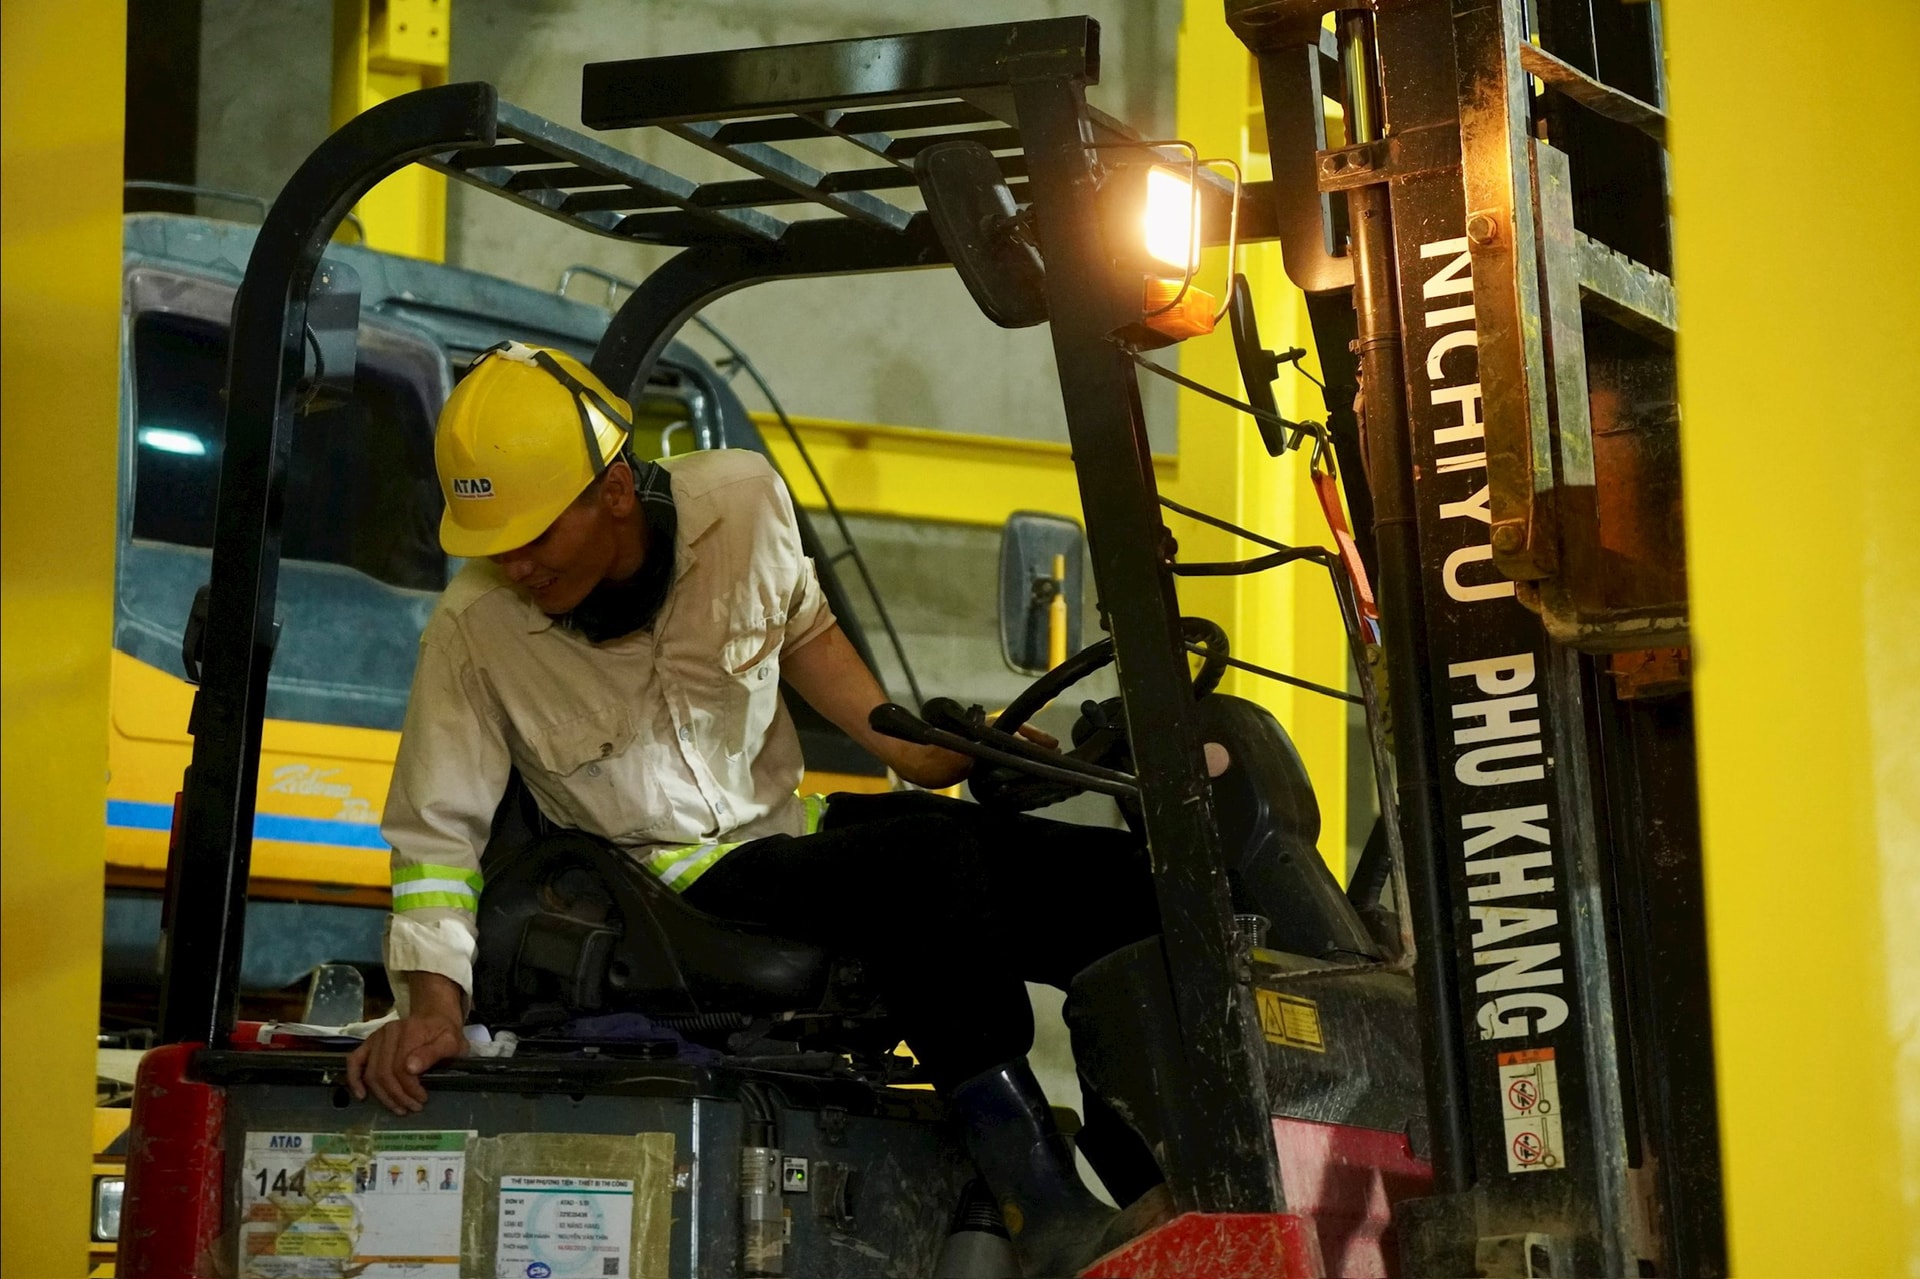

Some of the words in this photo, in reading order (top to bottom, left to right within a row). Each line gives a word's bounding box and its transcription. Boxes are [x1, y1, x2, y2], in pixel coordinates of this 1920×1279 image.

[1420, 237, 1514, 602] NICHIYU
[454, 478, 491, 493] ATAD
[1462, 803, 1569, 1041] KHANG
[270, 1136, 302, 1148] ATAD
[256, 1167, 305, 1196] 144
